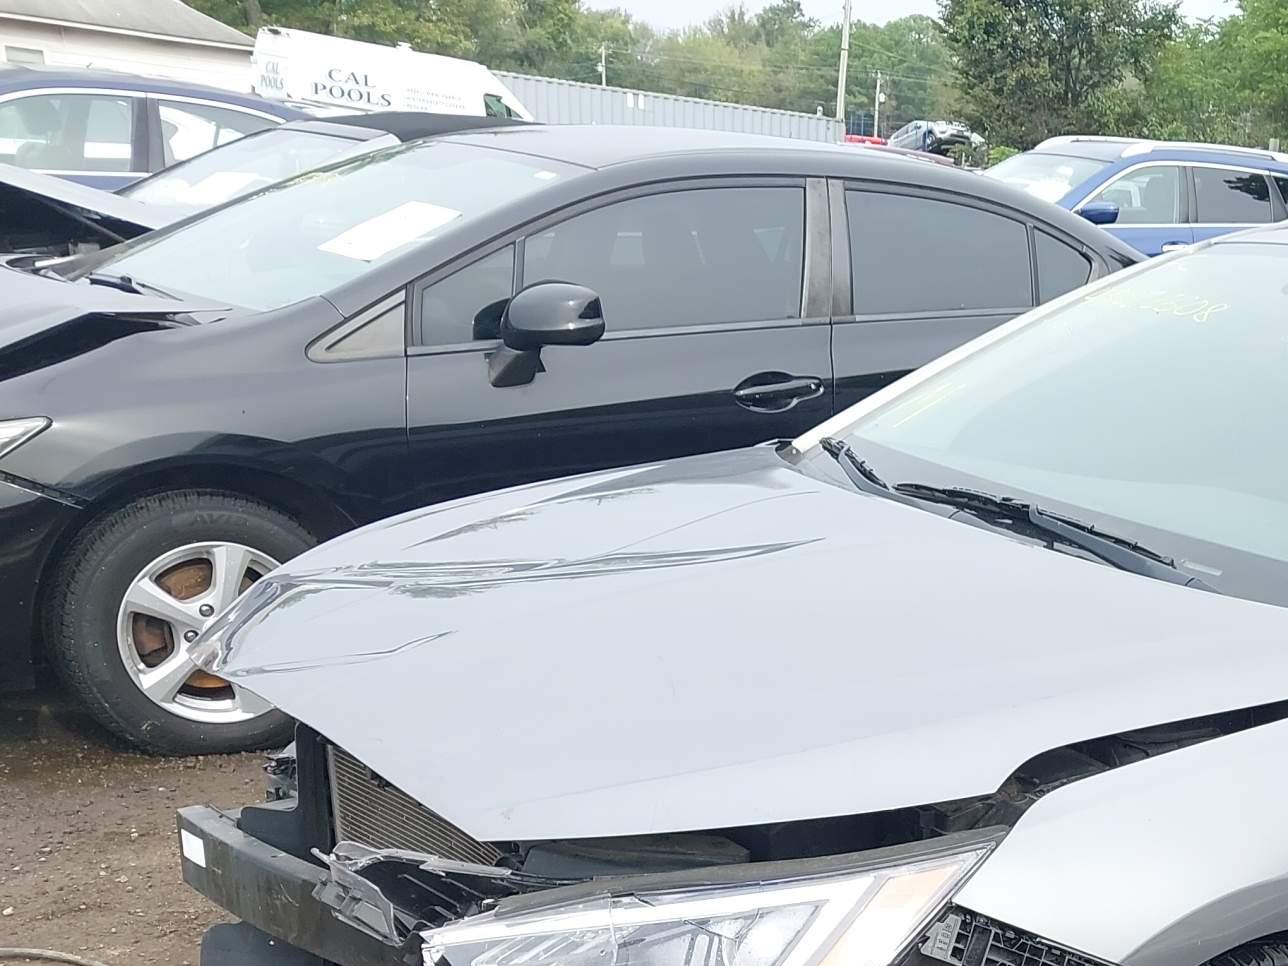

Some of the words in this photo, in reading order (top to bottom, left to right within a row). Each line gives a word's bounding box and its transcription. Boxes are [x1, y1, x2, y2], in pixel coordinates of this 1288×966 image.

[265, 61, 279, 74] CAL
[261, 74, 284, 90] POOLS
[328, 68, 376, 88] CAL
[313, 82, 392, 107] POOLS
